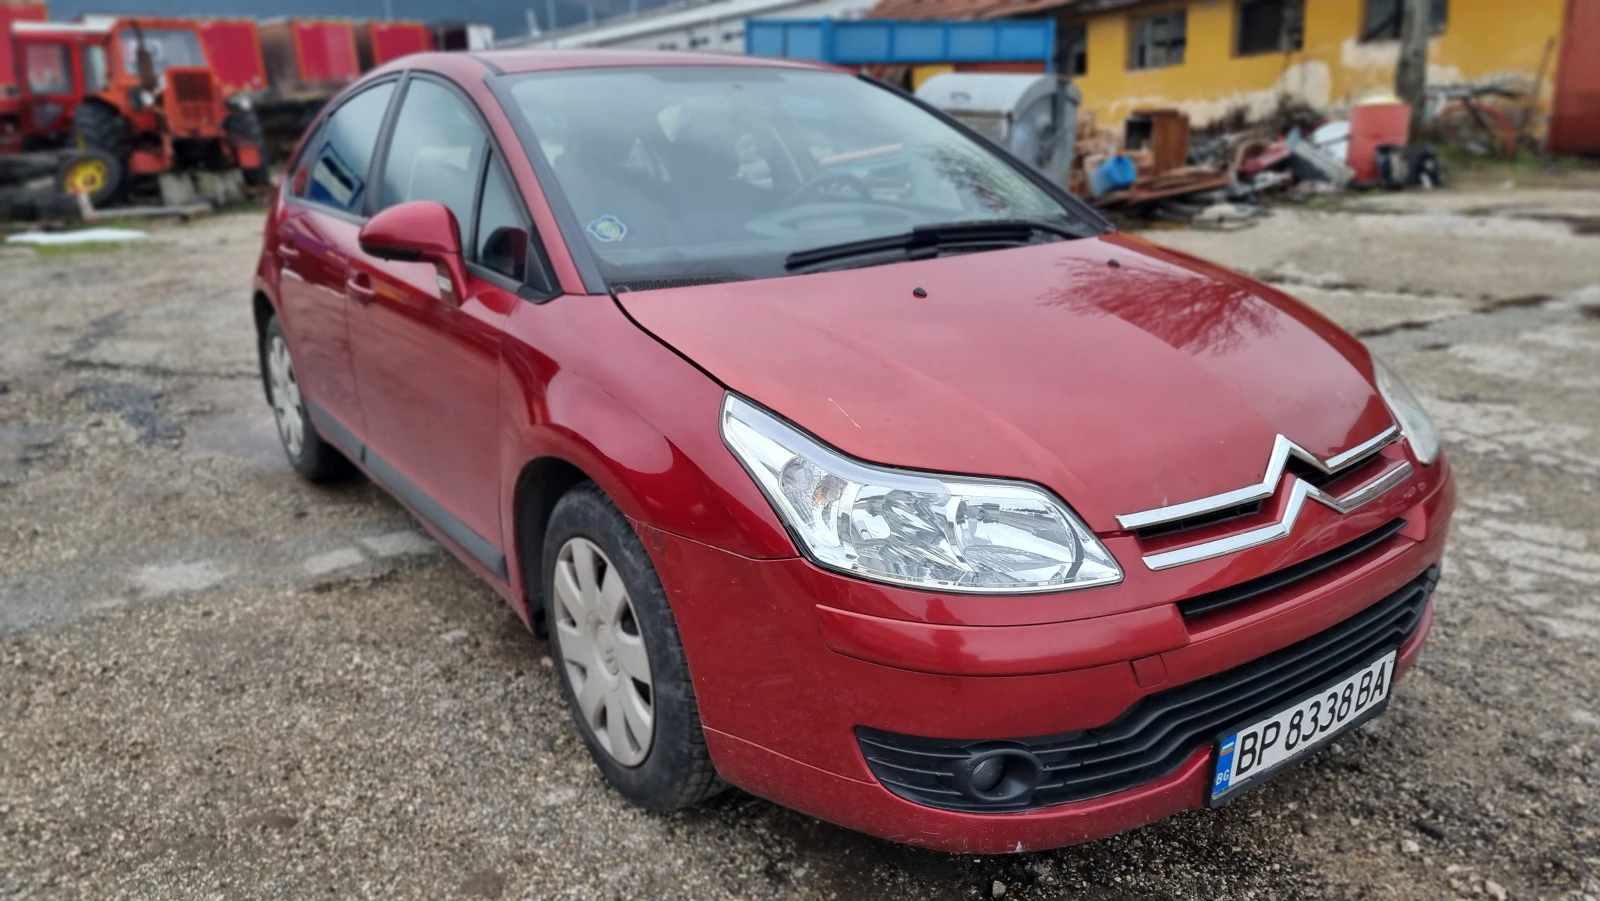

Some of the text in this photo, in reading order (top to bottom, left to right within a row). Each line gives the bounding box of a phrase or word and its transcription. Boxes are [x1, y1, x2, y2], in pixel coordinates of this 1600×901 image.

[1235, 660, 1386, 777] BP 8338 BA
[1215, 769, 1230, 786] BG
